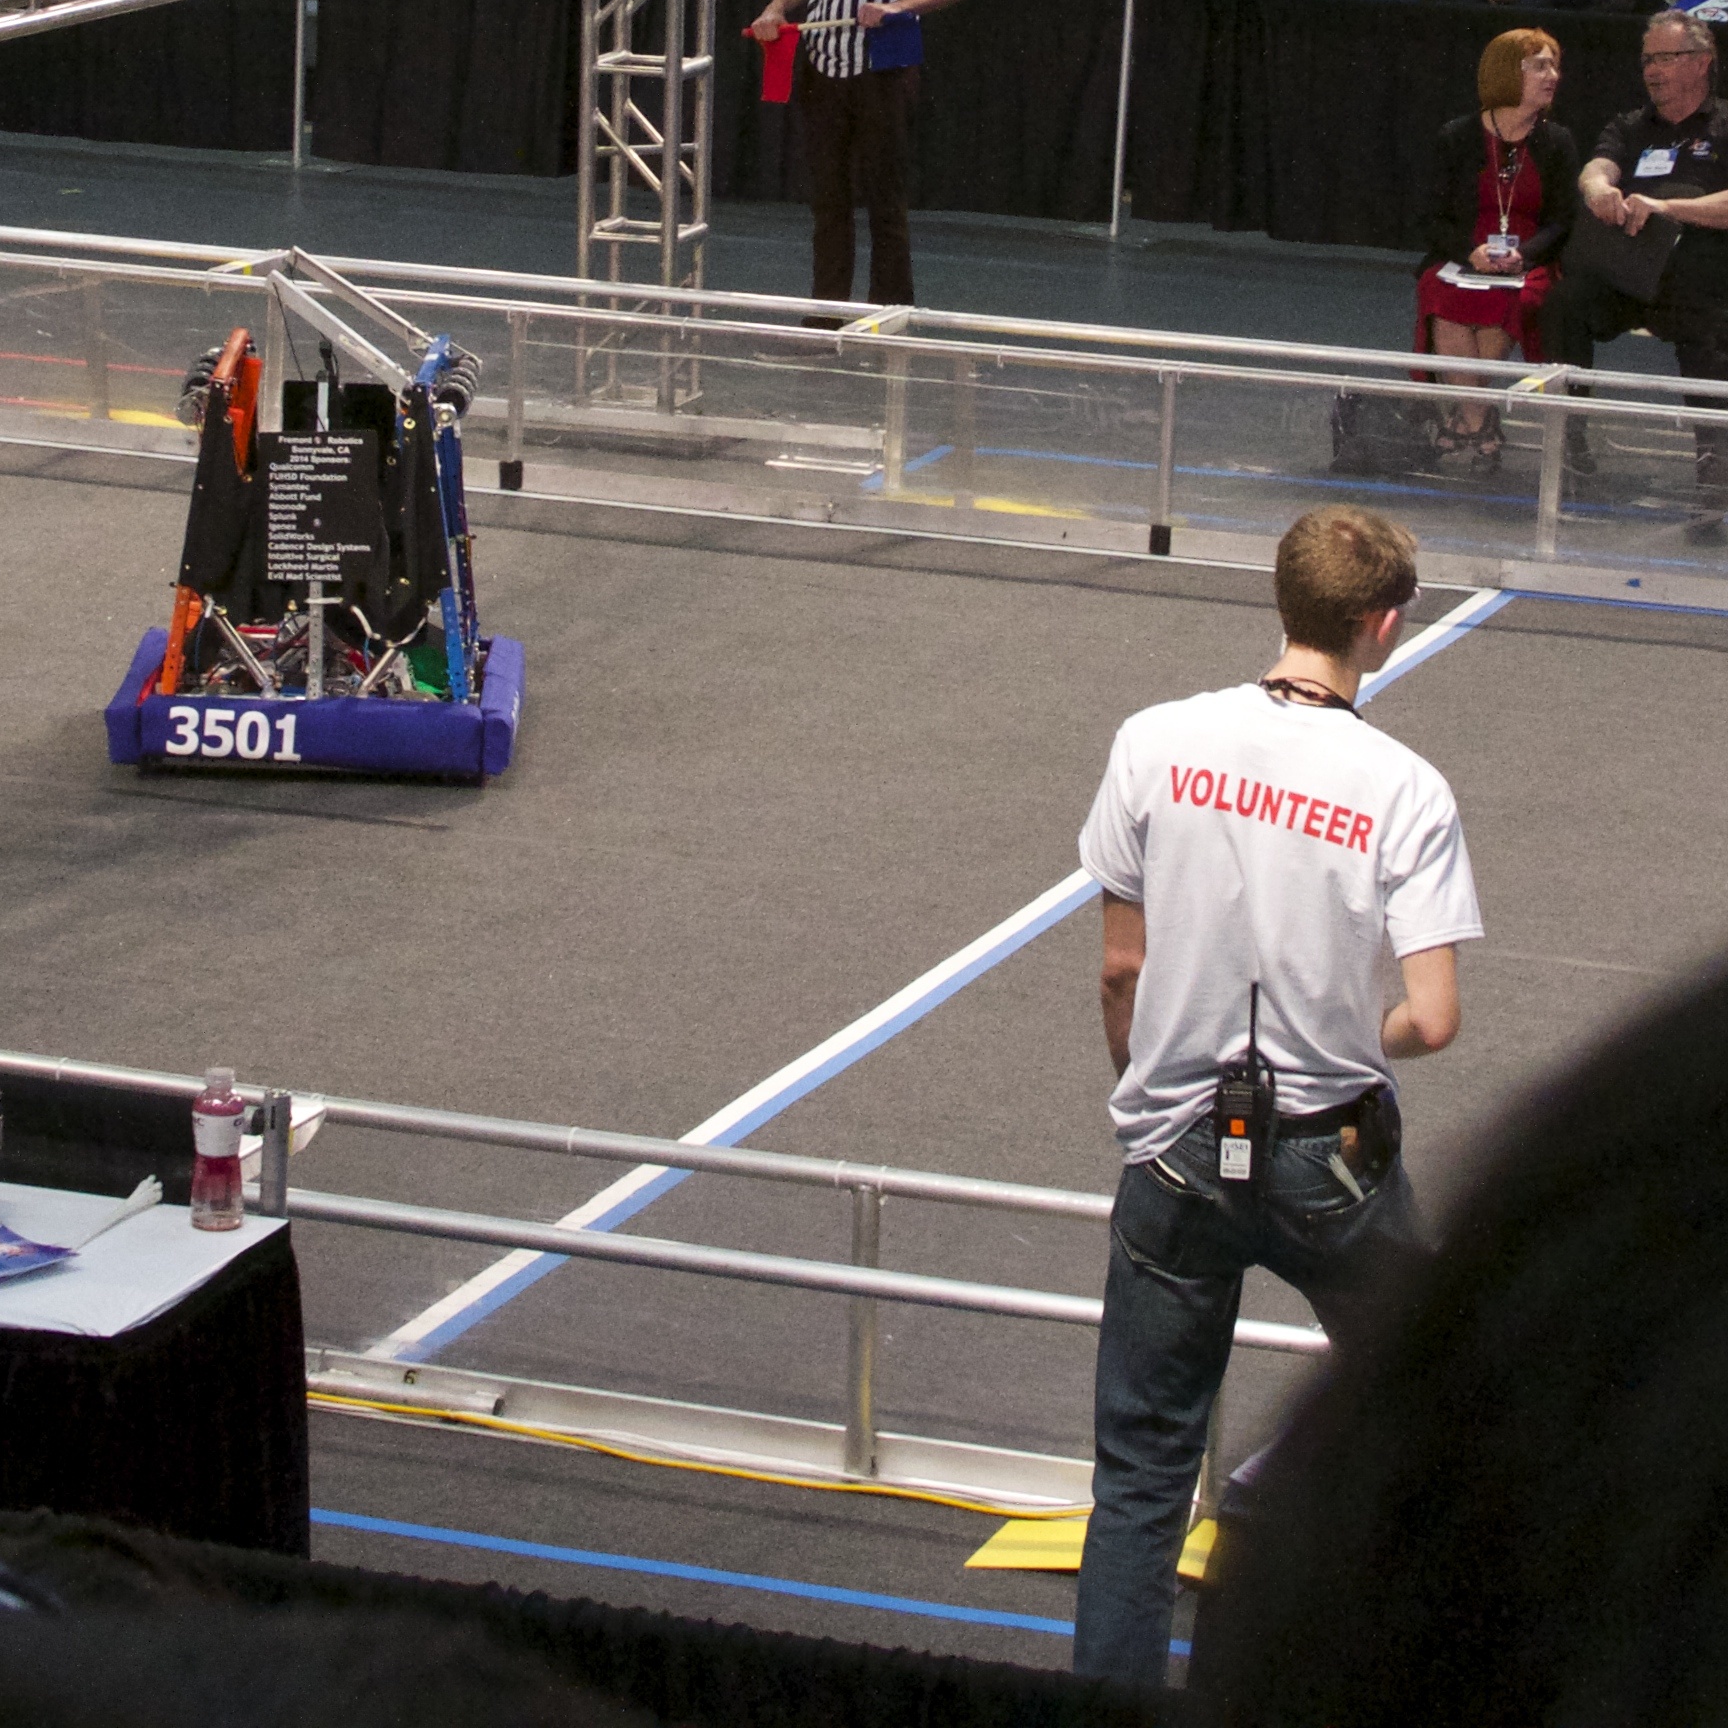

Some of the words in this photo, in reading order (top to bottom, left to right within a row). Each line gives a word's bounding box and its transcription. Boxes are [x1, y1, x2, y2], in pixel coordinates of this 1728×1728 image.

[327, 436, 363, 445] Robotics
[337, 446, 350, 454] CA
[269, 462, 314, 472] Qualcomm
[299, 473, 347, 482] Foundation
[269, 482, 310, 492] Symantec
[299, 493, 322, 502] Fund
[268, 532, 315, 541] SolidWorks
[268, 542, 304, 551] Cadence
[306, 543, 334, 553] Design
[336, 543, 371, 553] Systems
[268, 552, 304, 561] Intuitive
[306, 553, 340, 562] Surgical
[268, 562, 309, 571] Lockheed
[310, 563, 339, 571] Martin
[268, 572, 284, 581] Evil
[286, 572, 303, 581] Mad
[305, 573, 342, 581] Scientist
[165, 705, 302, 762] 3501
[1170, 765, 1374, 854] VOLUNTEER
